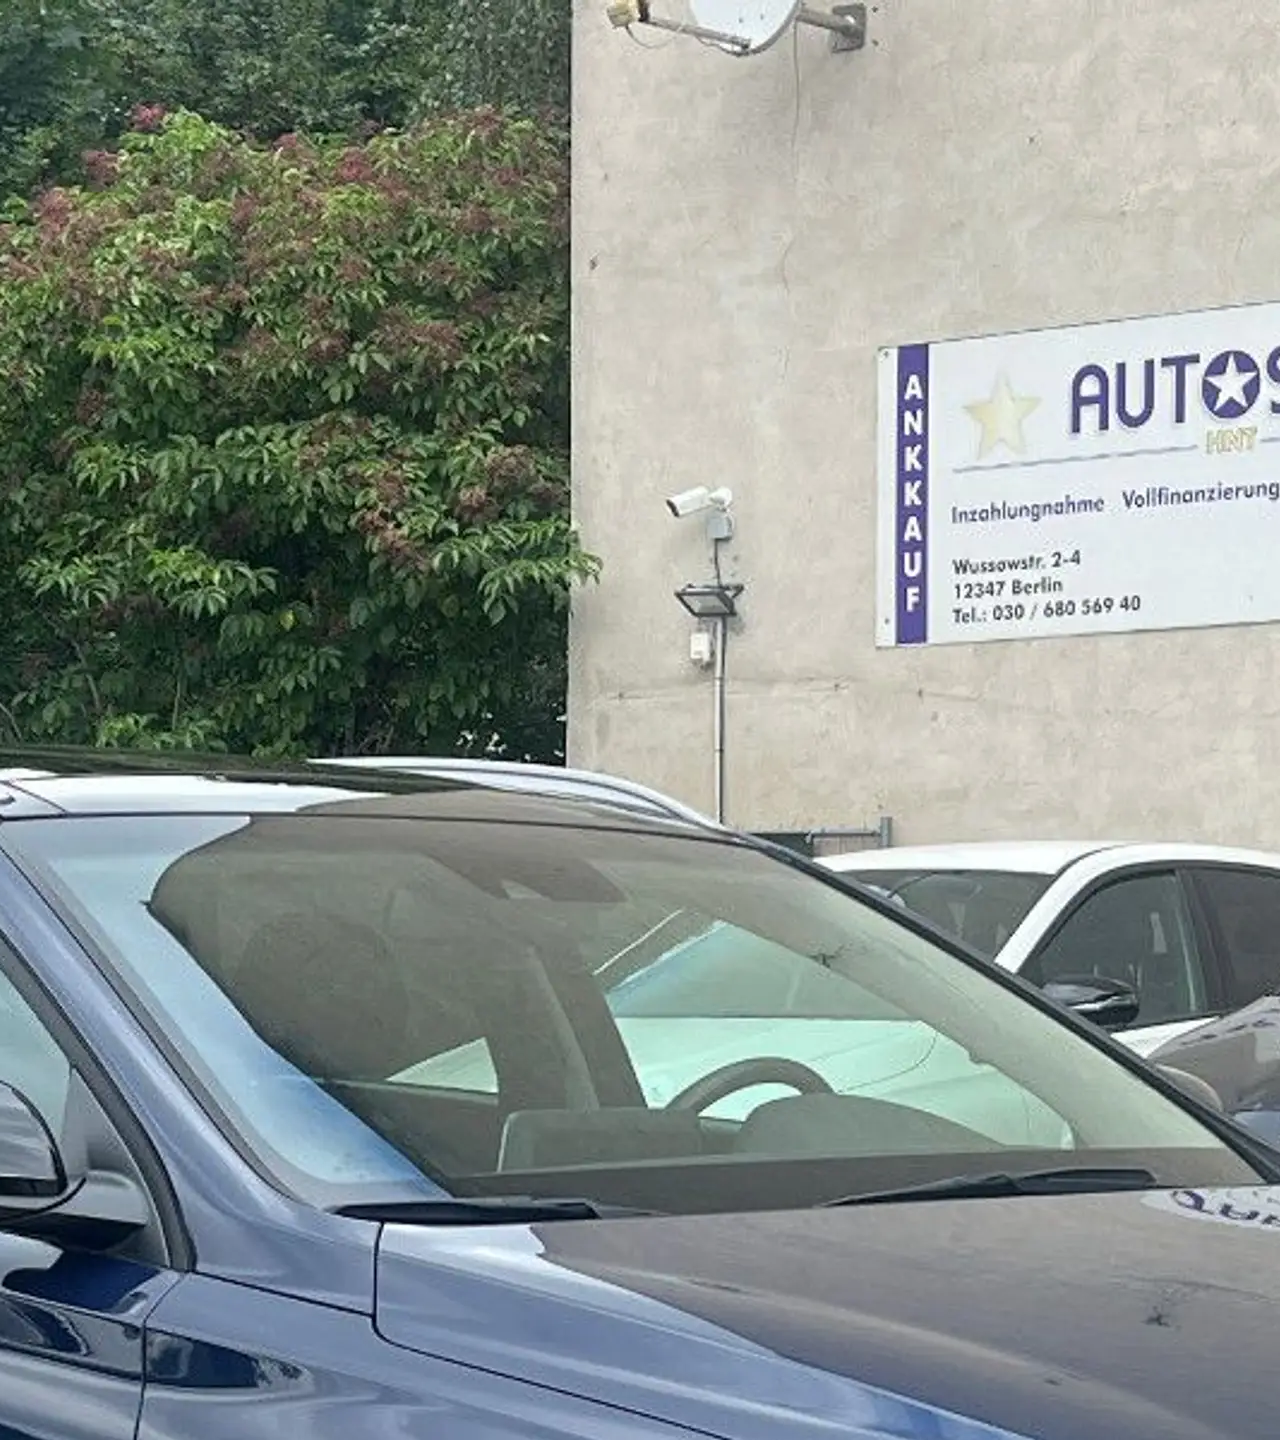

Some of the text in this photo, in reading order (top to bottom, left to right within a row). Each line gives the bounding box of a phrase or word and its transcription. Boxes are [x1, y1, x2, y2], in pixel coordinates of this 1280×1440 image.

[902, 374, 923, 613] ANKKAUF
[952, 495, 1104, 524] Inzahlungnahme
[1122, 480, 1280, 509] Vollfinanzierung
[953, 550, 1081, 575] Wussowstr. 2-4
[954, 577, 1063, 599] 12347 Berlin
[953, 606, 987, 624] Tel.:
[993, 602, 1024, 621] 030
[1043, 600, 1076, 618] 680
[1081, 597, 1113, 615] 569
[1120, 595, 1142, 611] 40
